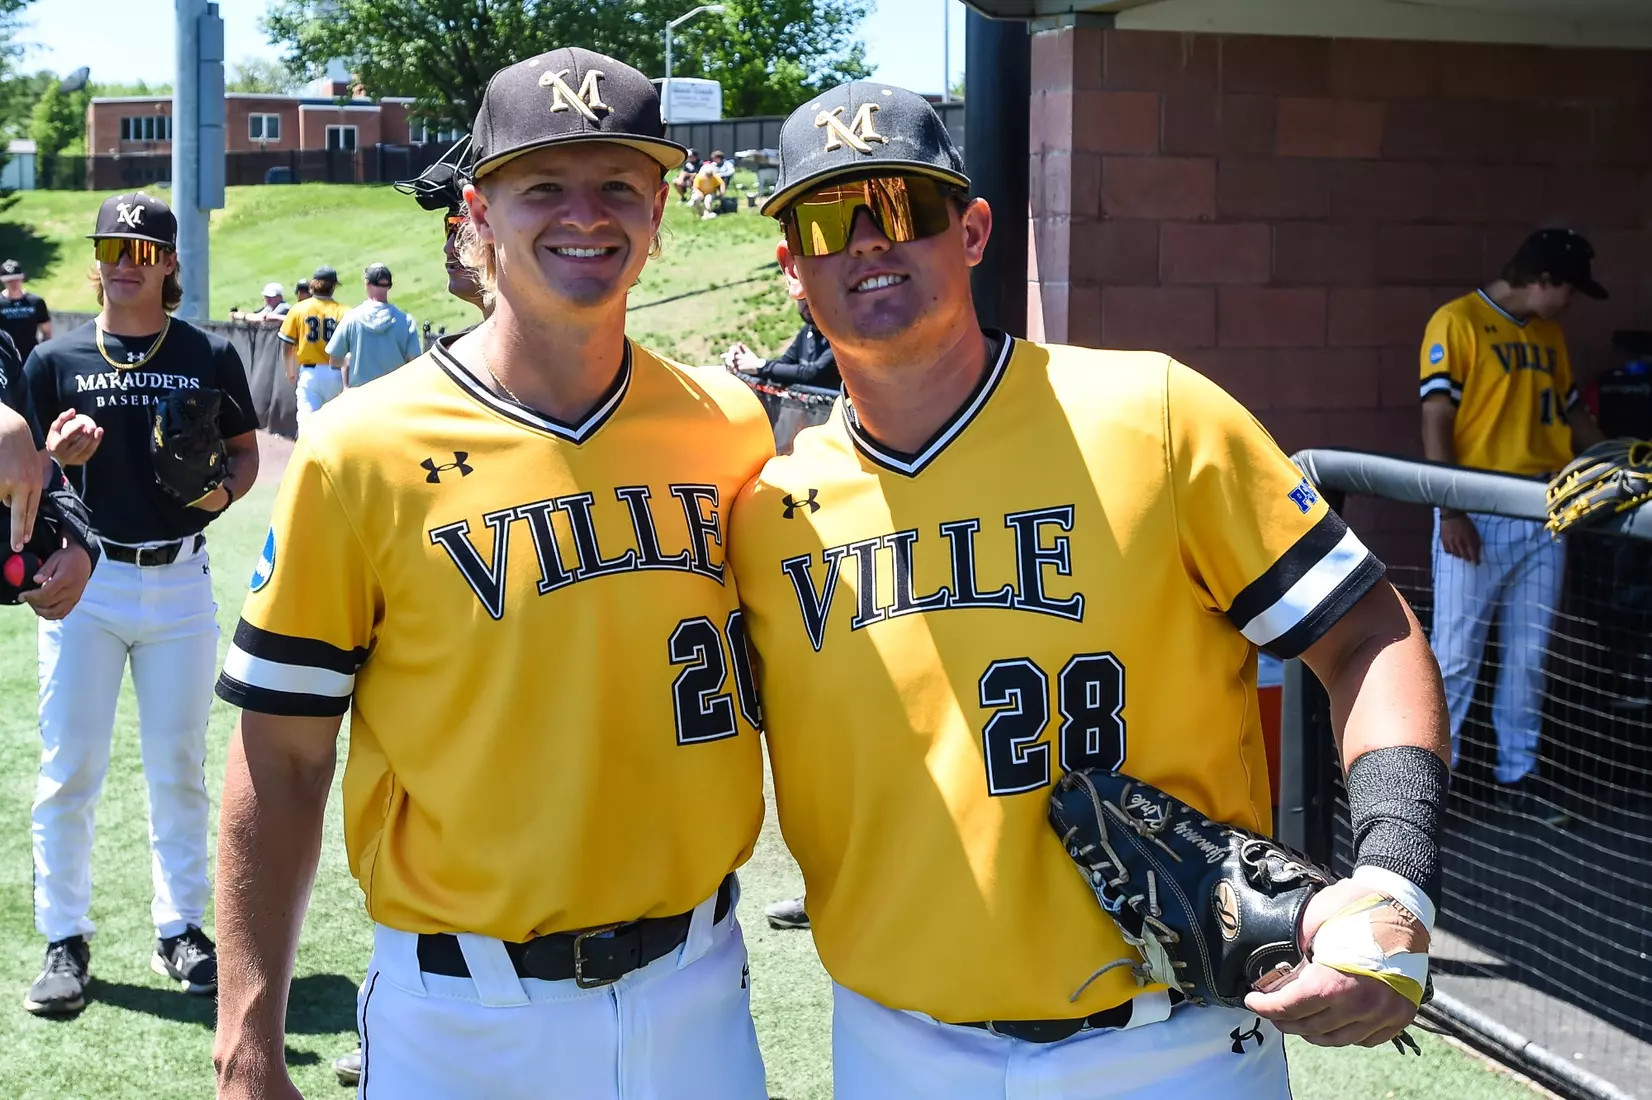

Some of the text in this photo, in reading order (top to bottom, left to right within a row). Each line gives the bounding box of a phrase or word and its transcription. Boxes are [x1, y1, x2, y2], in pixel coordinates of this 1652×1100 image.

[75, 371, 200, 392] MARAUDERS
[428, 483, 726, 621] VILLE
[781, 504, 1085, 652] VILLE
[978, 651, 1126, 797] 28
